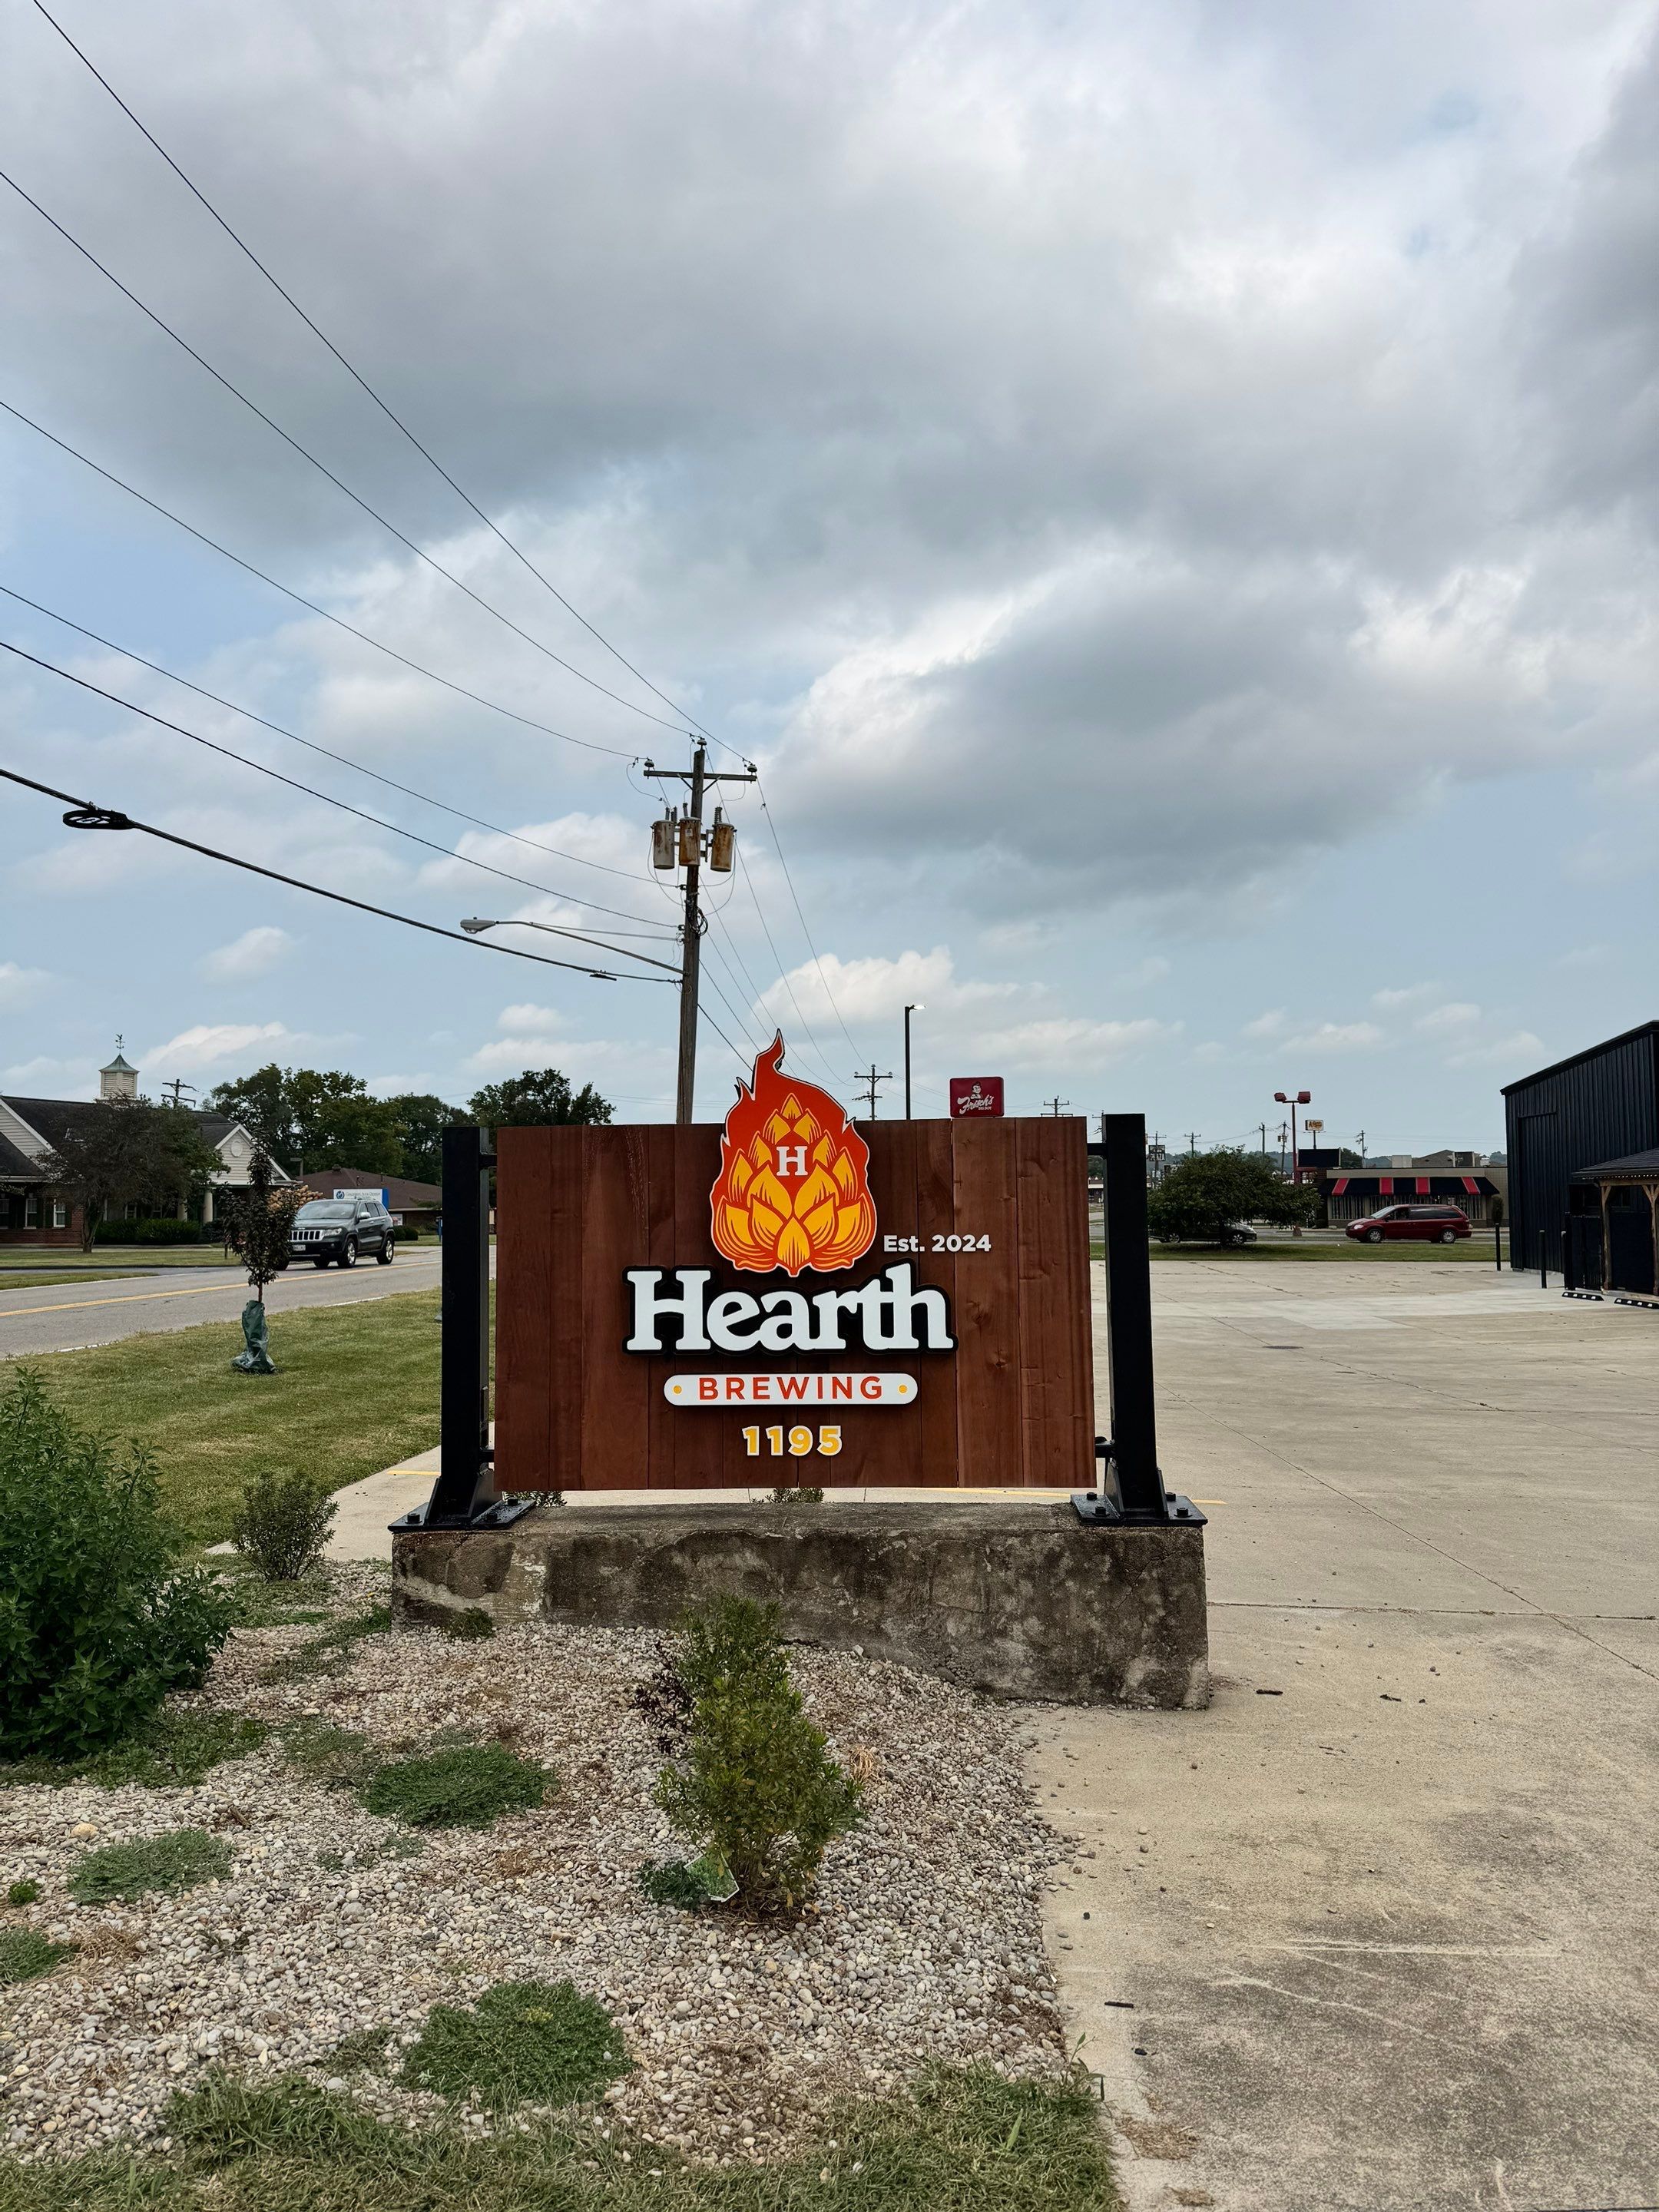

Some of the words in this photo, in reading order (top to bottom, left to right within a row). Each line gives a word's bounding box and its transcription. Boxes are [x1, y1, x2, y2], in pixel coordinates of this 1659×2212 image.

[957, 1094, 994, 1114] Frisch's
[777, 1146, 808, 1176] H
[883, 1234, 925, 1252] Est.
[932, 1234, 992, 1252] 2024
[627, 1263, 954, 1350] Hearth
[699, 1376, 882, 1399] BREWING
[742, 1426, 843, 1455] 1195
